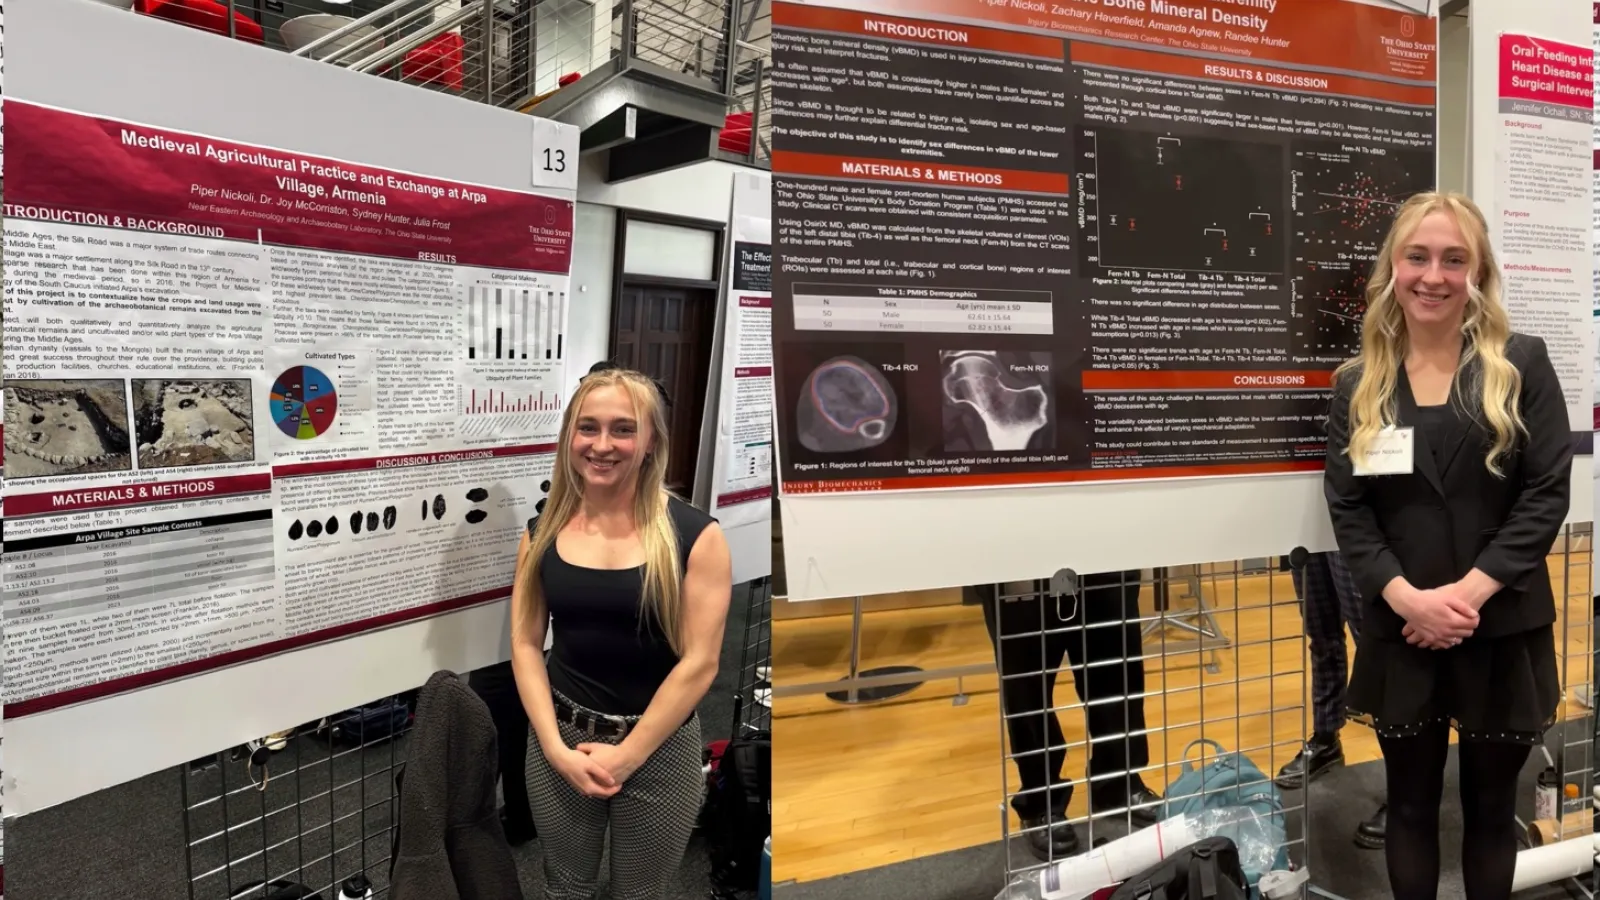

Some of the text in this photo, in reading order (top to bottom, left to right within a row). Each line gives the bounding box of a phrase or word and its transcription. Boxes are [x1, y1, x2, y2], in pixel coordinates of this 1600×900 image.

[1010, 0, 1047, 12] Nickoli,
[1051, 4, 1092, 21] Zachary
[1094, 11, 1144, 27] Haverfield,
[1148, 19, 1186, 33] Amanda
[1188, 25, 1221, 38] Agnew,
[1224, 30, 1258, 43] Randee
[1260, 36, 1289, 47] Hunter
[1151, 0, 1207, 20] Mineral
[1212, 8, 1268, 32] Density
[864, 19, 968, 42] INTRODUCTION
[1028, 18, 1048, 31] Injury
[1051, 21, 1101, 34] Biomechanics
[1104, 28, 1138, 39] Research
[1140, 34, 1166, 43] Center,
[1182, 40, 1198, 48] Ohio
[1201, 42, 1217, 51] State
[1219, 46, 1251, 56] University
[1380, 36, 1436, 51] THE OHIO STATE
[1386, 46, 1429, 59] UNIVERSITY
[1512, 44, 1593, 66] Oral Feeding Inf
[1204, 64, 1327, 88] RESULTS & DISCUSSION
[1512, 60, 1540, 73] Heart
[1543, 66, 1582, 80] Disease
[1512, 76, 1554, 92] Surgical
[1505, 120, 1542, 130] Background
[789, 128, 827, 137] objective
[838, 132, 854, 140] this
[855, 134, 877, 143] study
[898, 137, 927, 147] identify
[943, 142, 984, 151] differences
[995, 146, 1016, 154] vBMD
[121, 129, 486, 203] Medieval Agricultural Practice and Exchange at Arpa
[543, 148, 566, 172] 13
[842, 162, 1002, 184] MATERIALS & METHODS
[275, 175, 386, 204] Village, Armenia
[190, 183, 450, 229] Piper Nickoli, Dr. Joy McCorriston, Sydney Hunter, Julia Frost
[1504, 210, 1530, 218] Purpose
[3, 204, 223, 238] TRODUCTION & BACKGROUND
[188, 202, 207, 210] Near
[209, 204, 238, 214] Eastern
[240, 208, 284, 223] Archaeology
[300, 216, 348, 231] Archaeobotany
[349, 224, 383, 235] Laboratory,
[426, 234, 451, 244] University
[418, 251, 457, 264] RESULTS
[741, 250, 752, 260] The
[741, 261, 770, 272] Treatment
[1504, 264, 1572, 273] Methods/Measurements
[929, 290, 977, 298] Demographics
[304, 352, 356, 362] Cultivated Types
[1234, 376, 1305, 385] CONCLUSIONS
[376, 450, 494, 468] DISCUSSION & CONCLUSIONS
[52, 480, 214, 506] MATERIALS & METHODS
[783, 480, 883, 489] INJURY BIOMECHANICS
[75, 534, 95, 543] Arpa
[97, 531, 123, 539] Village
[142, 525, 171, 534] Sample
[170, 520, 202, 530] Contexts
